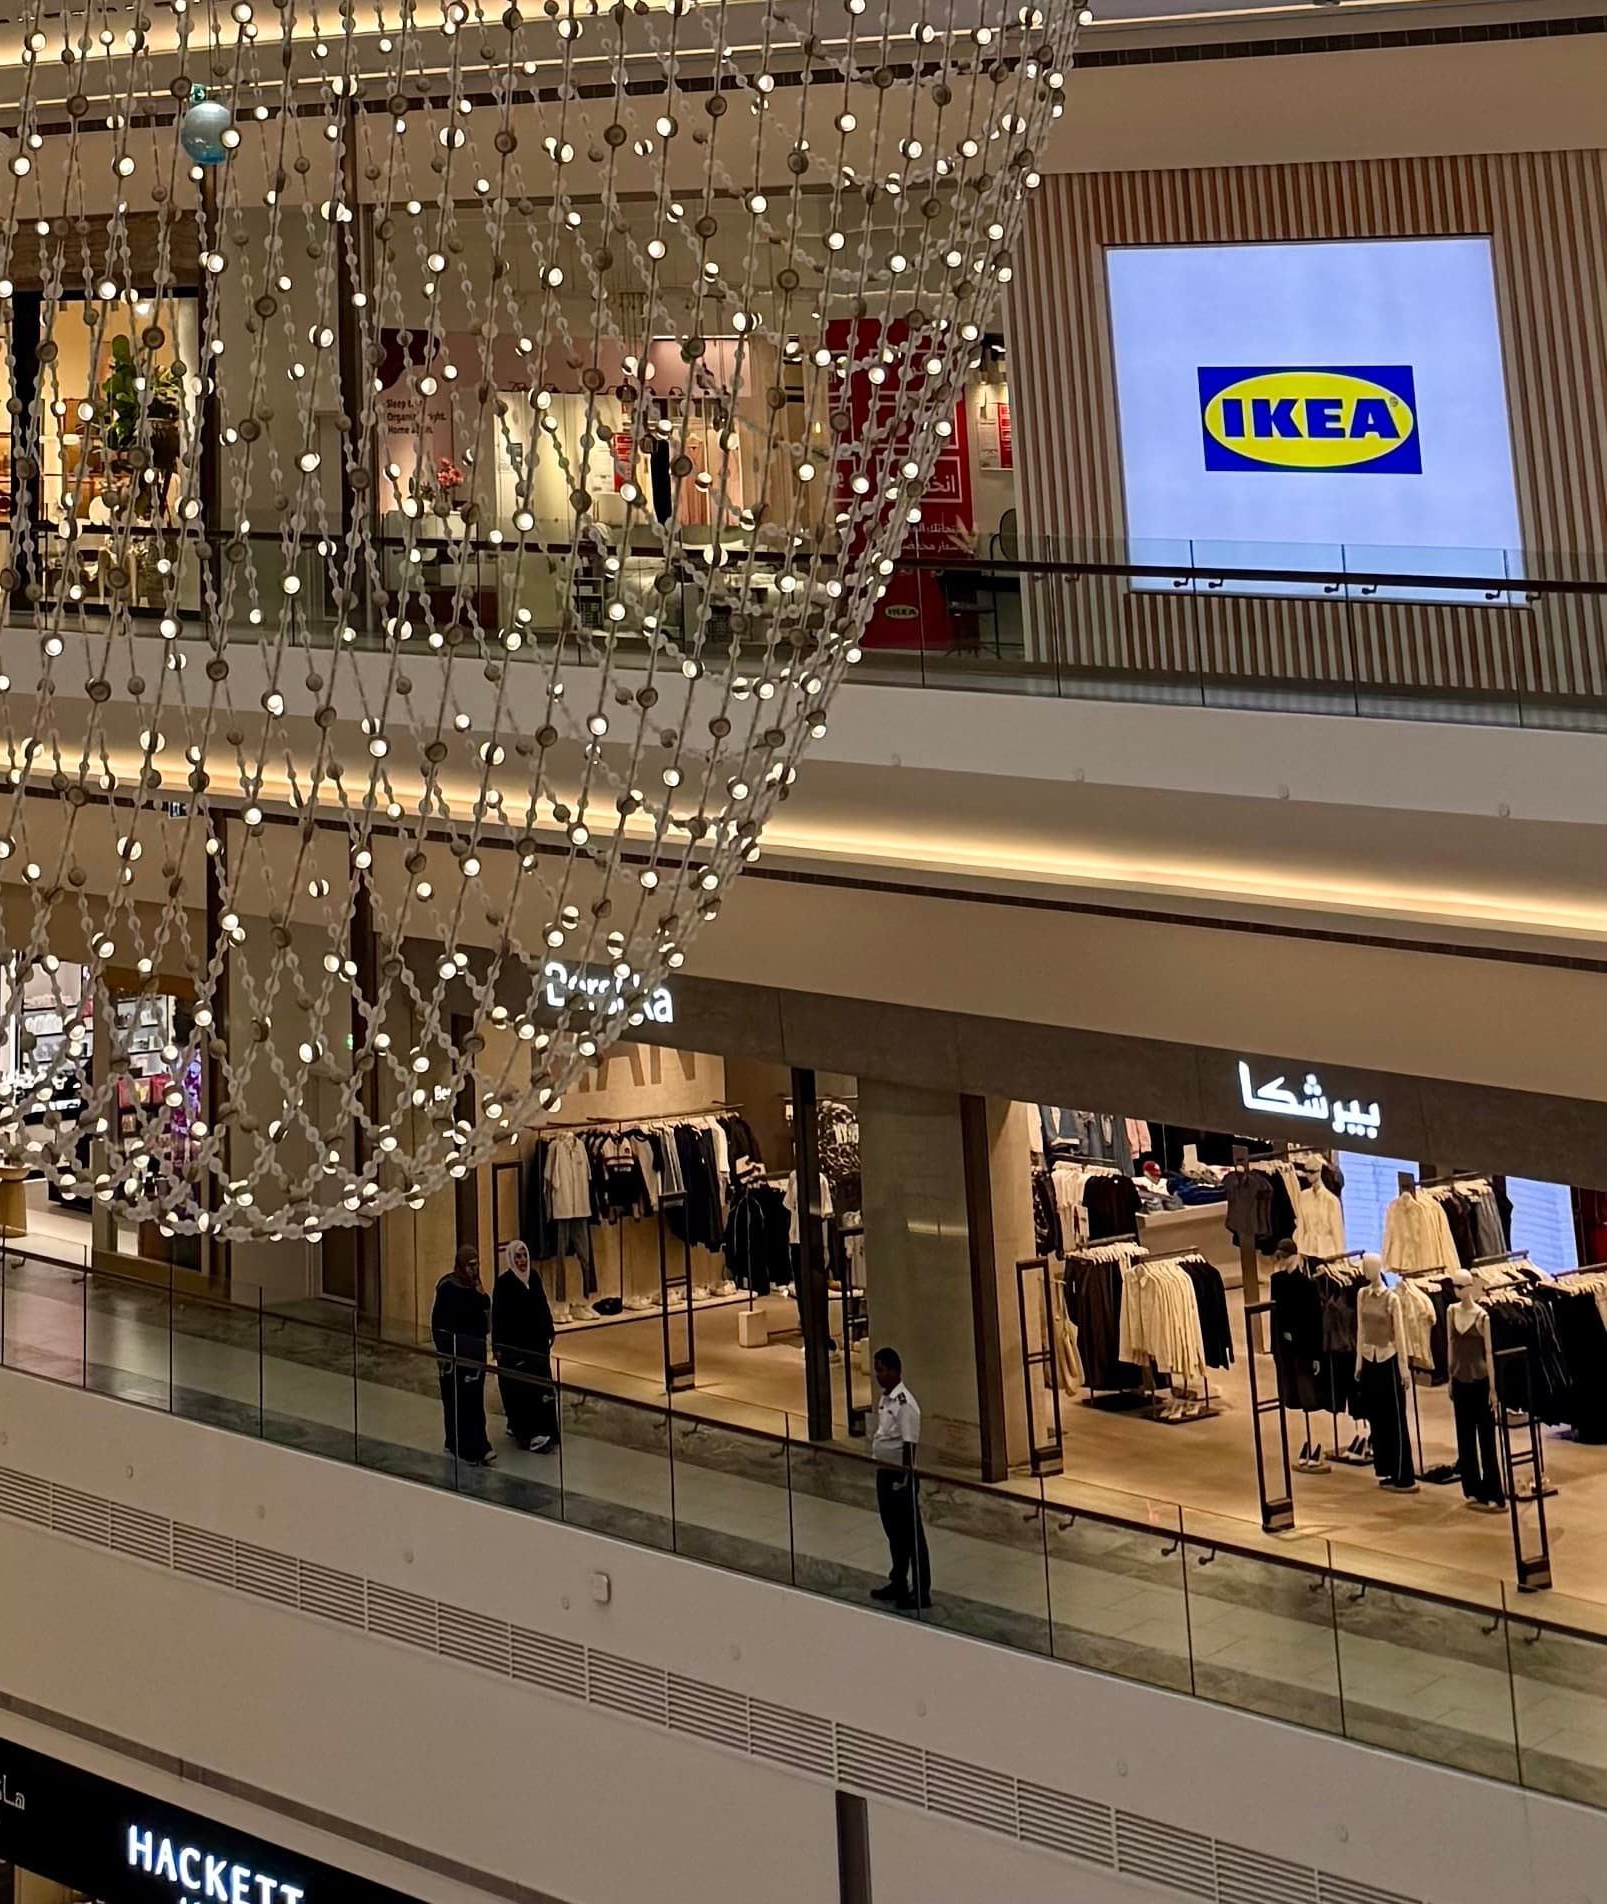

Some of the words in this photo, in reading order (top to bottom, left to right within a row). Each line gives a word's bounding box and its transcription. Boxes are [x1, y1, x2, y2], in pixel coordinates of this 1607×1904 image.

[1221, 398, 1401, 439] IKEA
[1238, 1060, 1381, 1140] بيرشكا
[128, 1824, 305, 1904] HACKETT
